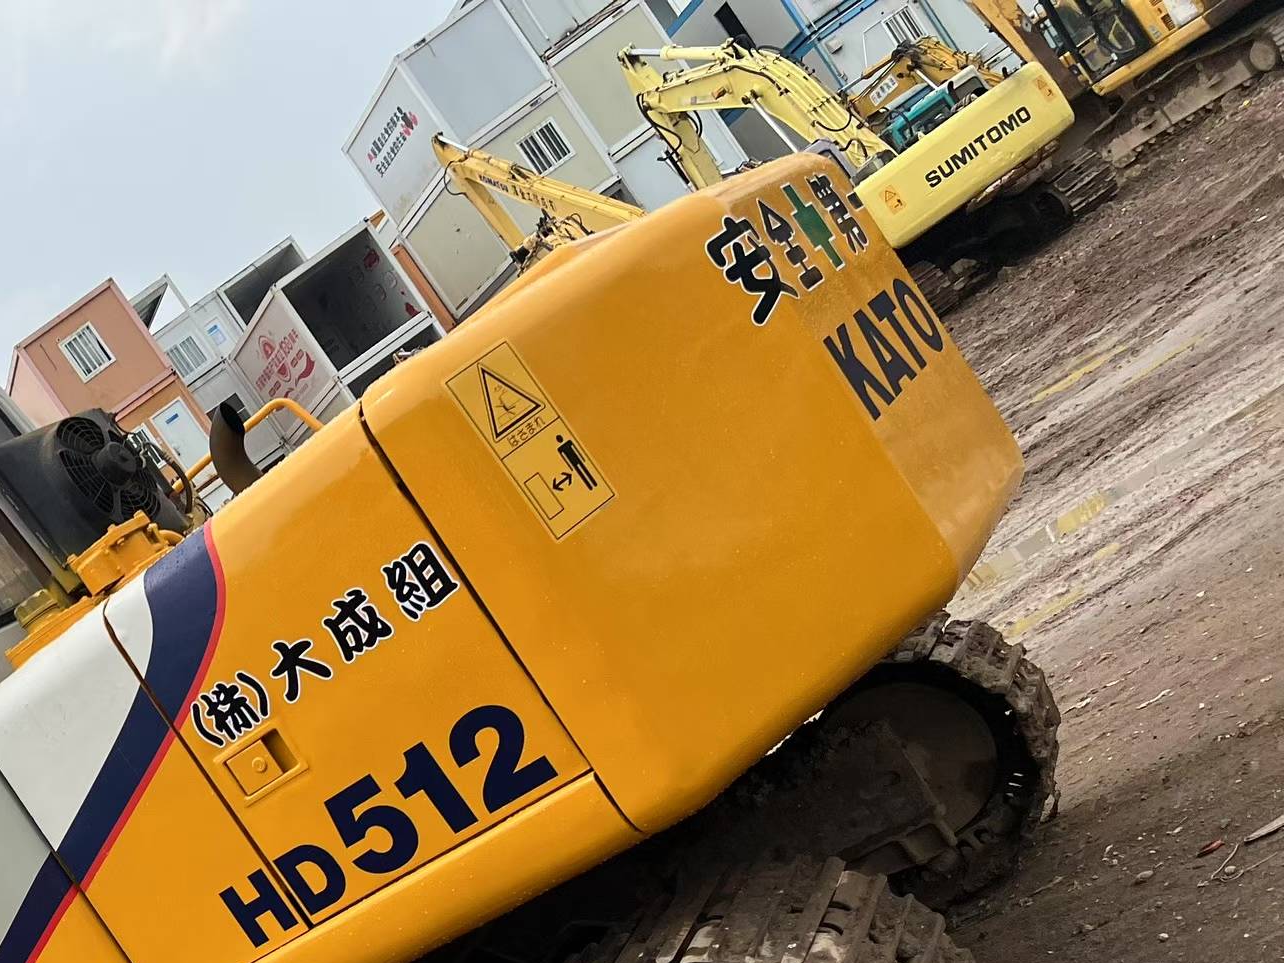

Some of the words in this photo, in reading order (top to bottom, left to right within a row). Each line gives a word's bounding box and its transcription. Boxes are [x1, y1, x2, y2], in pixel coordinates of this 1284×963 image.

[925, 106, 1031, 188] SUMITOMO
[823, 278, 944, 421] KATO
[507, 416, 546, 447] はさまれ
[219, 705, 559, 948] HD512
